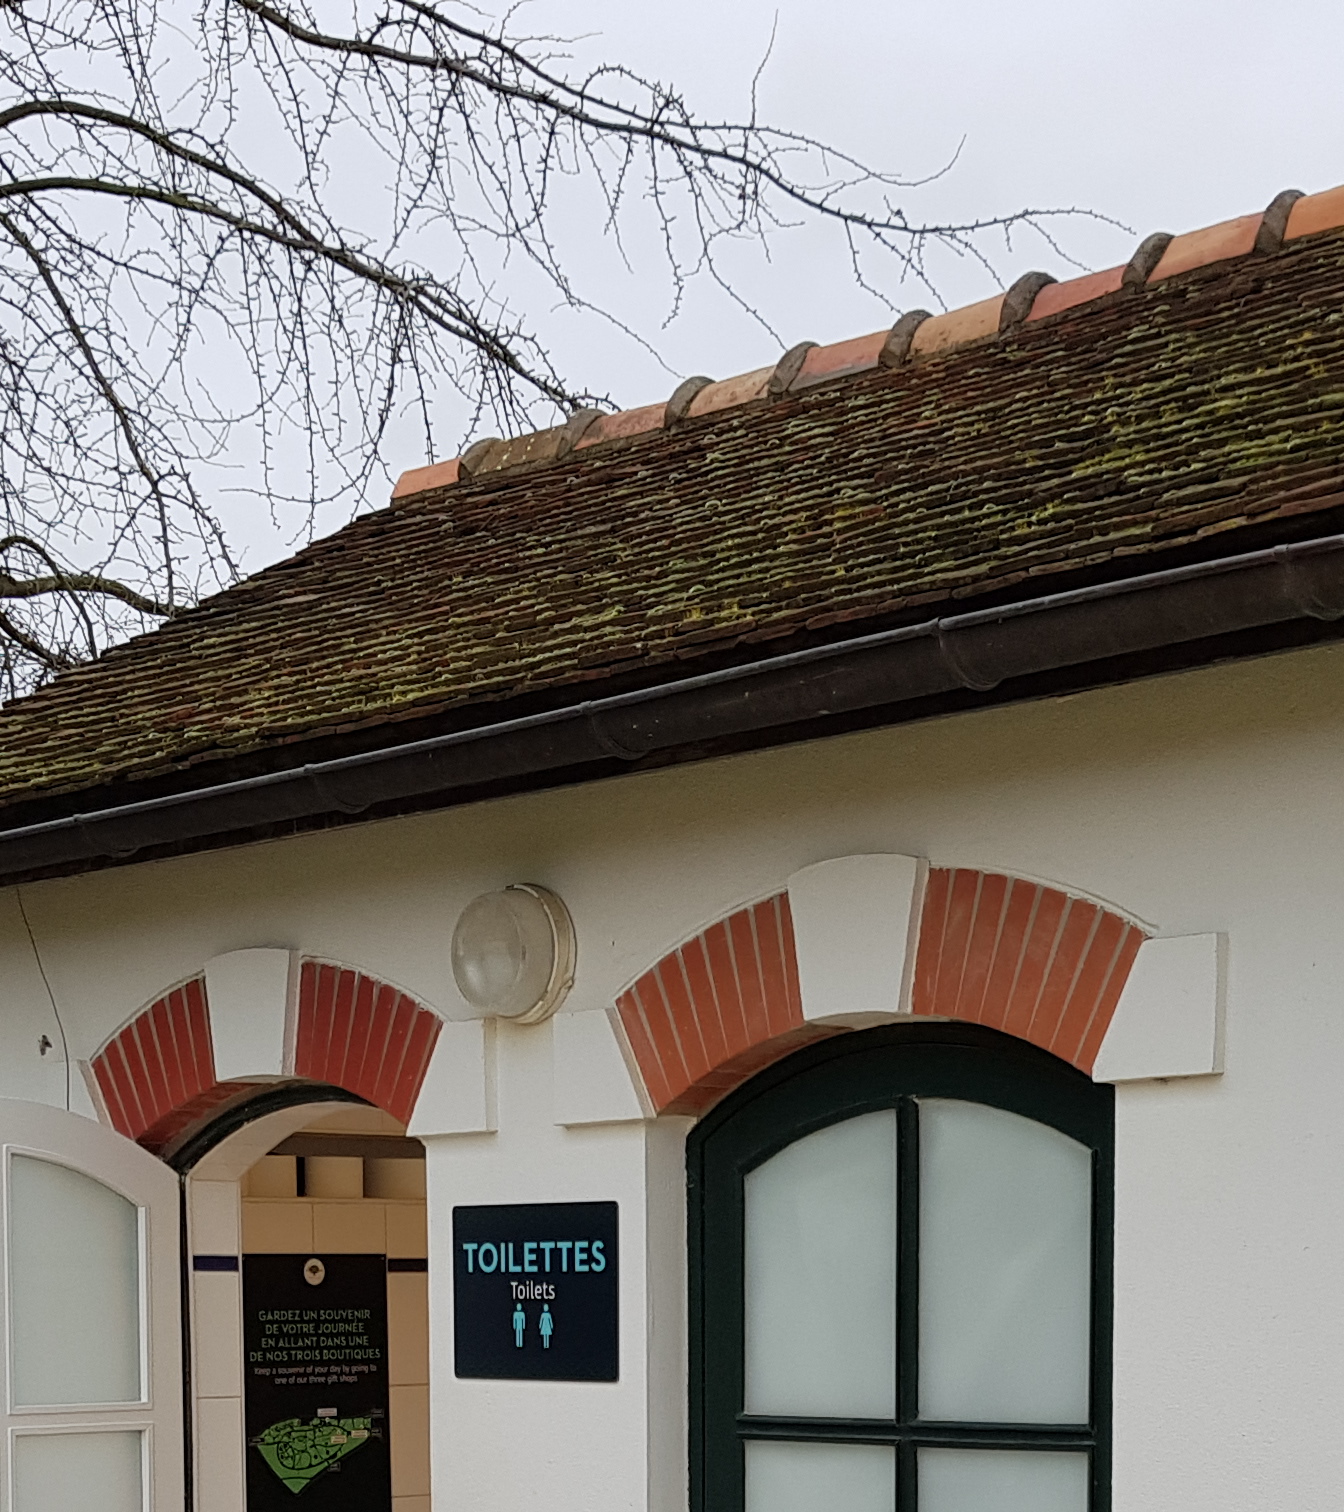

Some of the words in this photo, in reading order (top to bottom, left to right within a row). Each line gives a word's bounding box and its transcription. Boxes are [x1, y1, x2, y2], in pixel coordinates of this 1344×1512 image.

[463, 1241, 606, 1273] TOILETTES
[510, 1281, 555, 1299] Toilets
[259, 1310, 300, 1320] GARDEZ
[303, 1310, 317, 1320] UN
[320, 1310, 370, 1319] SOUVENIR
[266, 1324, 279, 1334] DE
[282, 1324, 315, 1334] VOTRE
[262, 1338, 275, 1347] EN
[278, 1337, 317, 1347] ALLANT
[320, 1336, 346, 1346] DANS
[349, 1336, 369, 1346] UNE
[250, 1352, 263, 1361] DE
[266, 1351, 288, 1361] NOS
[290, 1350, 320, 1360] TROIS
[323, 1349, 380, 1359] BOUTIQUES
